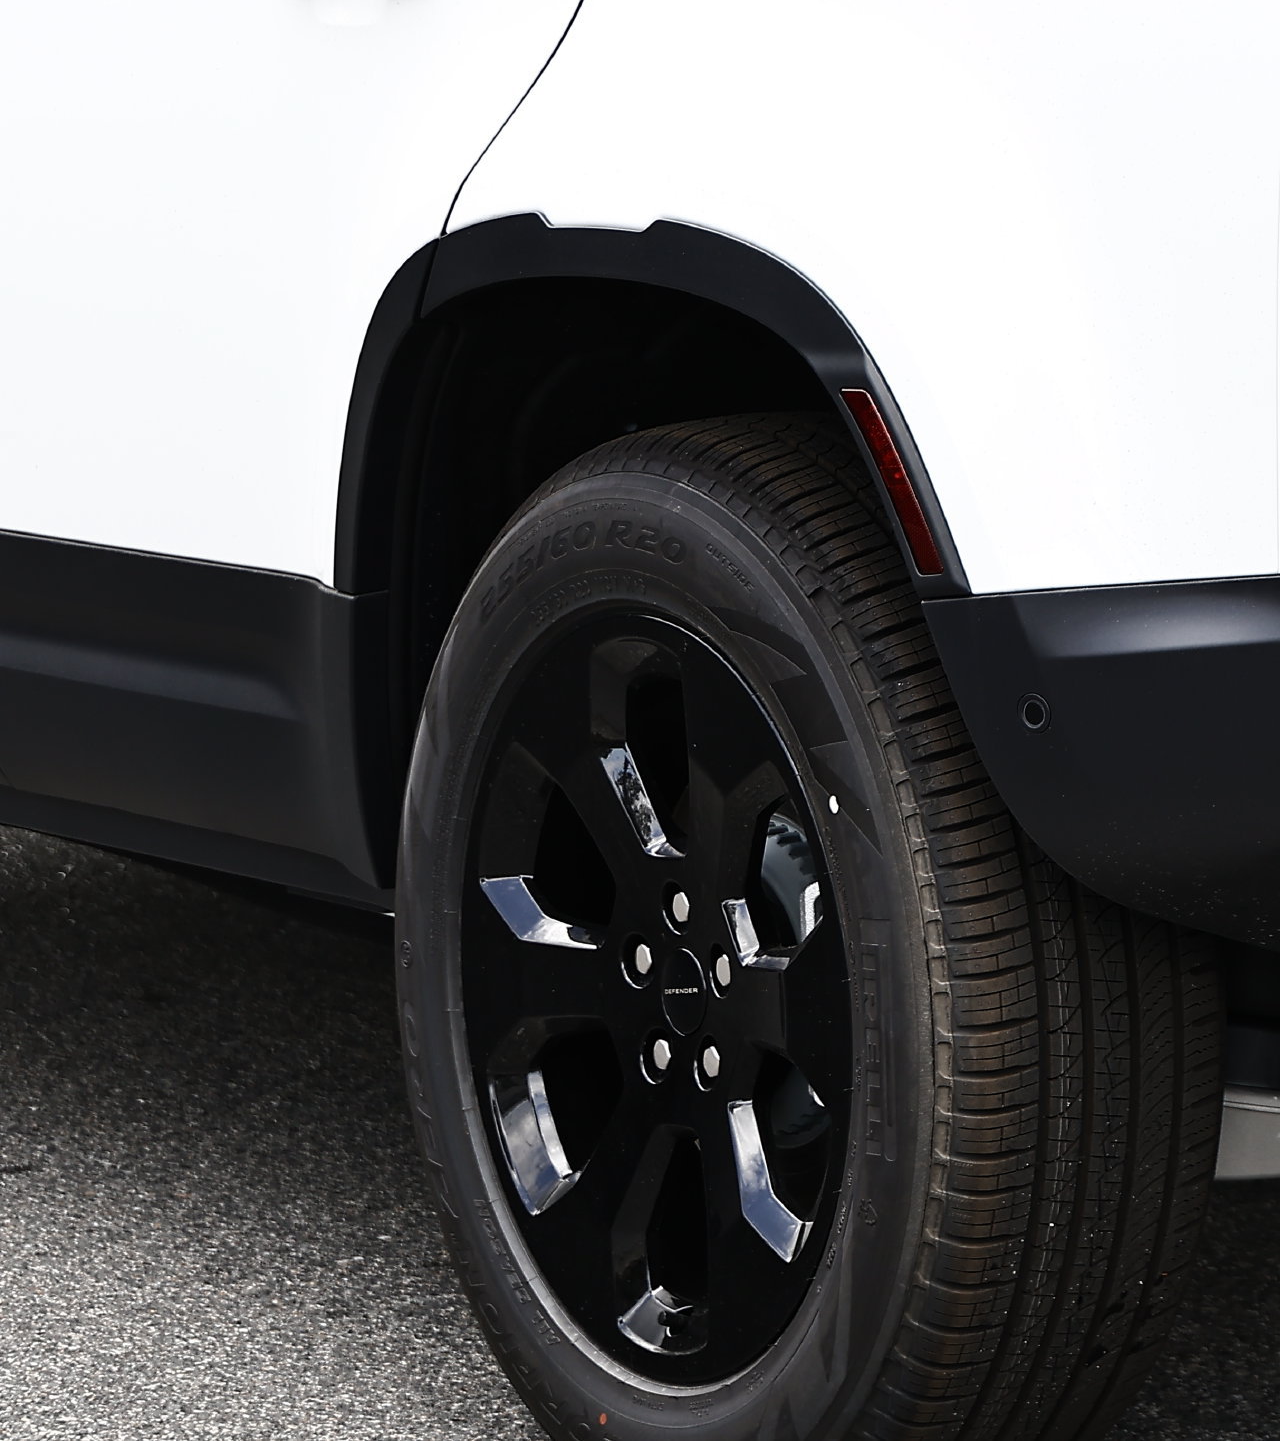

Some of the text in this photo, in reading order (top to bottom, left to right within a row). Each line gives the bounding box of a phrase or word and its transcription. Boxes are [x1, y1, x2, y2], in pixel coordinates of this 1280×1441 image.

[603, 518, 687, 566] R20
[704, 541, 756, 594] OUTSIDE
[663, 986, 699, 996] DEFENDER
[857, 916, 898, 1164] PIRELLI
